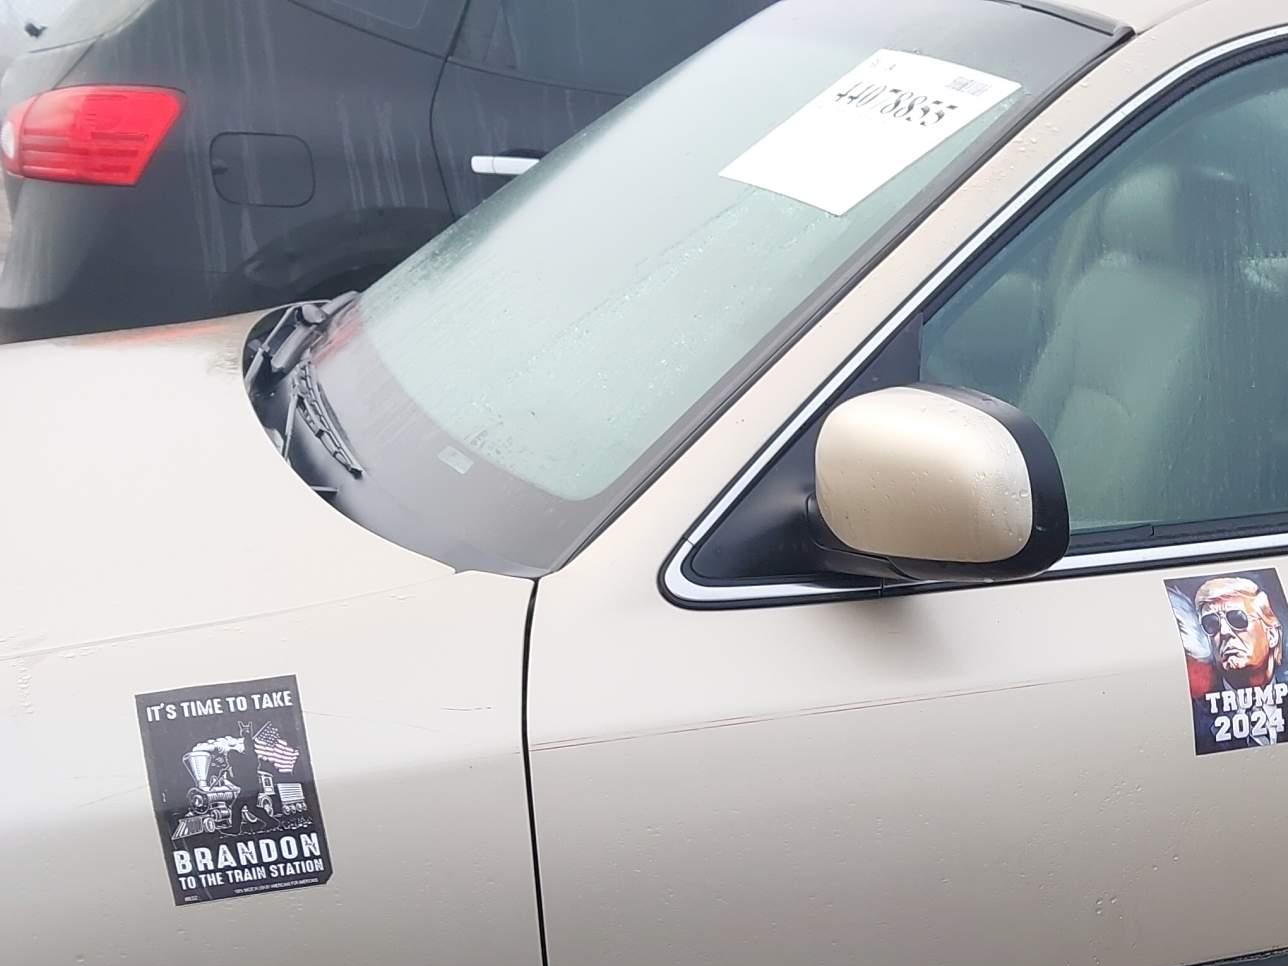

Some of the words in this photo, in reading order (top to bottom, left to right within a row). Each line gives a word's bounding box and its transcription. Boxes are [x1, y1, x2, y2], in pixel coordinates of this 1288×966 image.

[146, 703, 177, 722] IT'S
[180, 698, 224, 718] TIME
[225, 696, 248, 713] TO
[251, 690, 294, 710] TAKE
[1205, 682, 1288, 714] TRUMP
[1214, 707, 1285, 742] 2024
[173, 832, 321, 875] BRANDON
[178, 876, 197, 890] TO
[199, 871, 225, 888] THE
[226, 865, 267, 882] TRAIN
[270, 858, 325, 878] STATION
